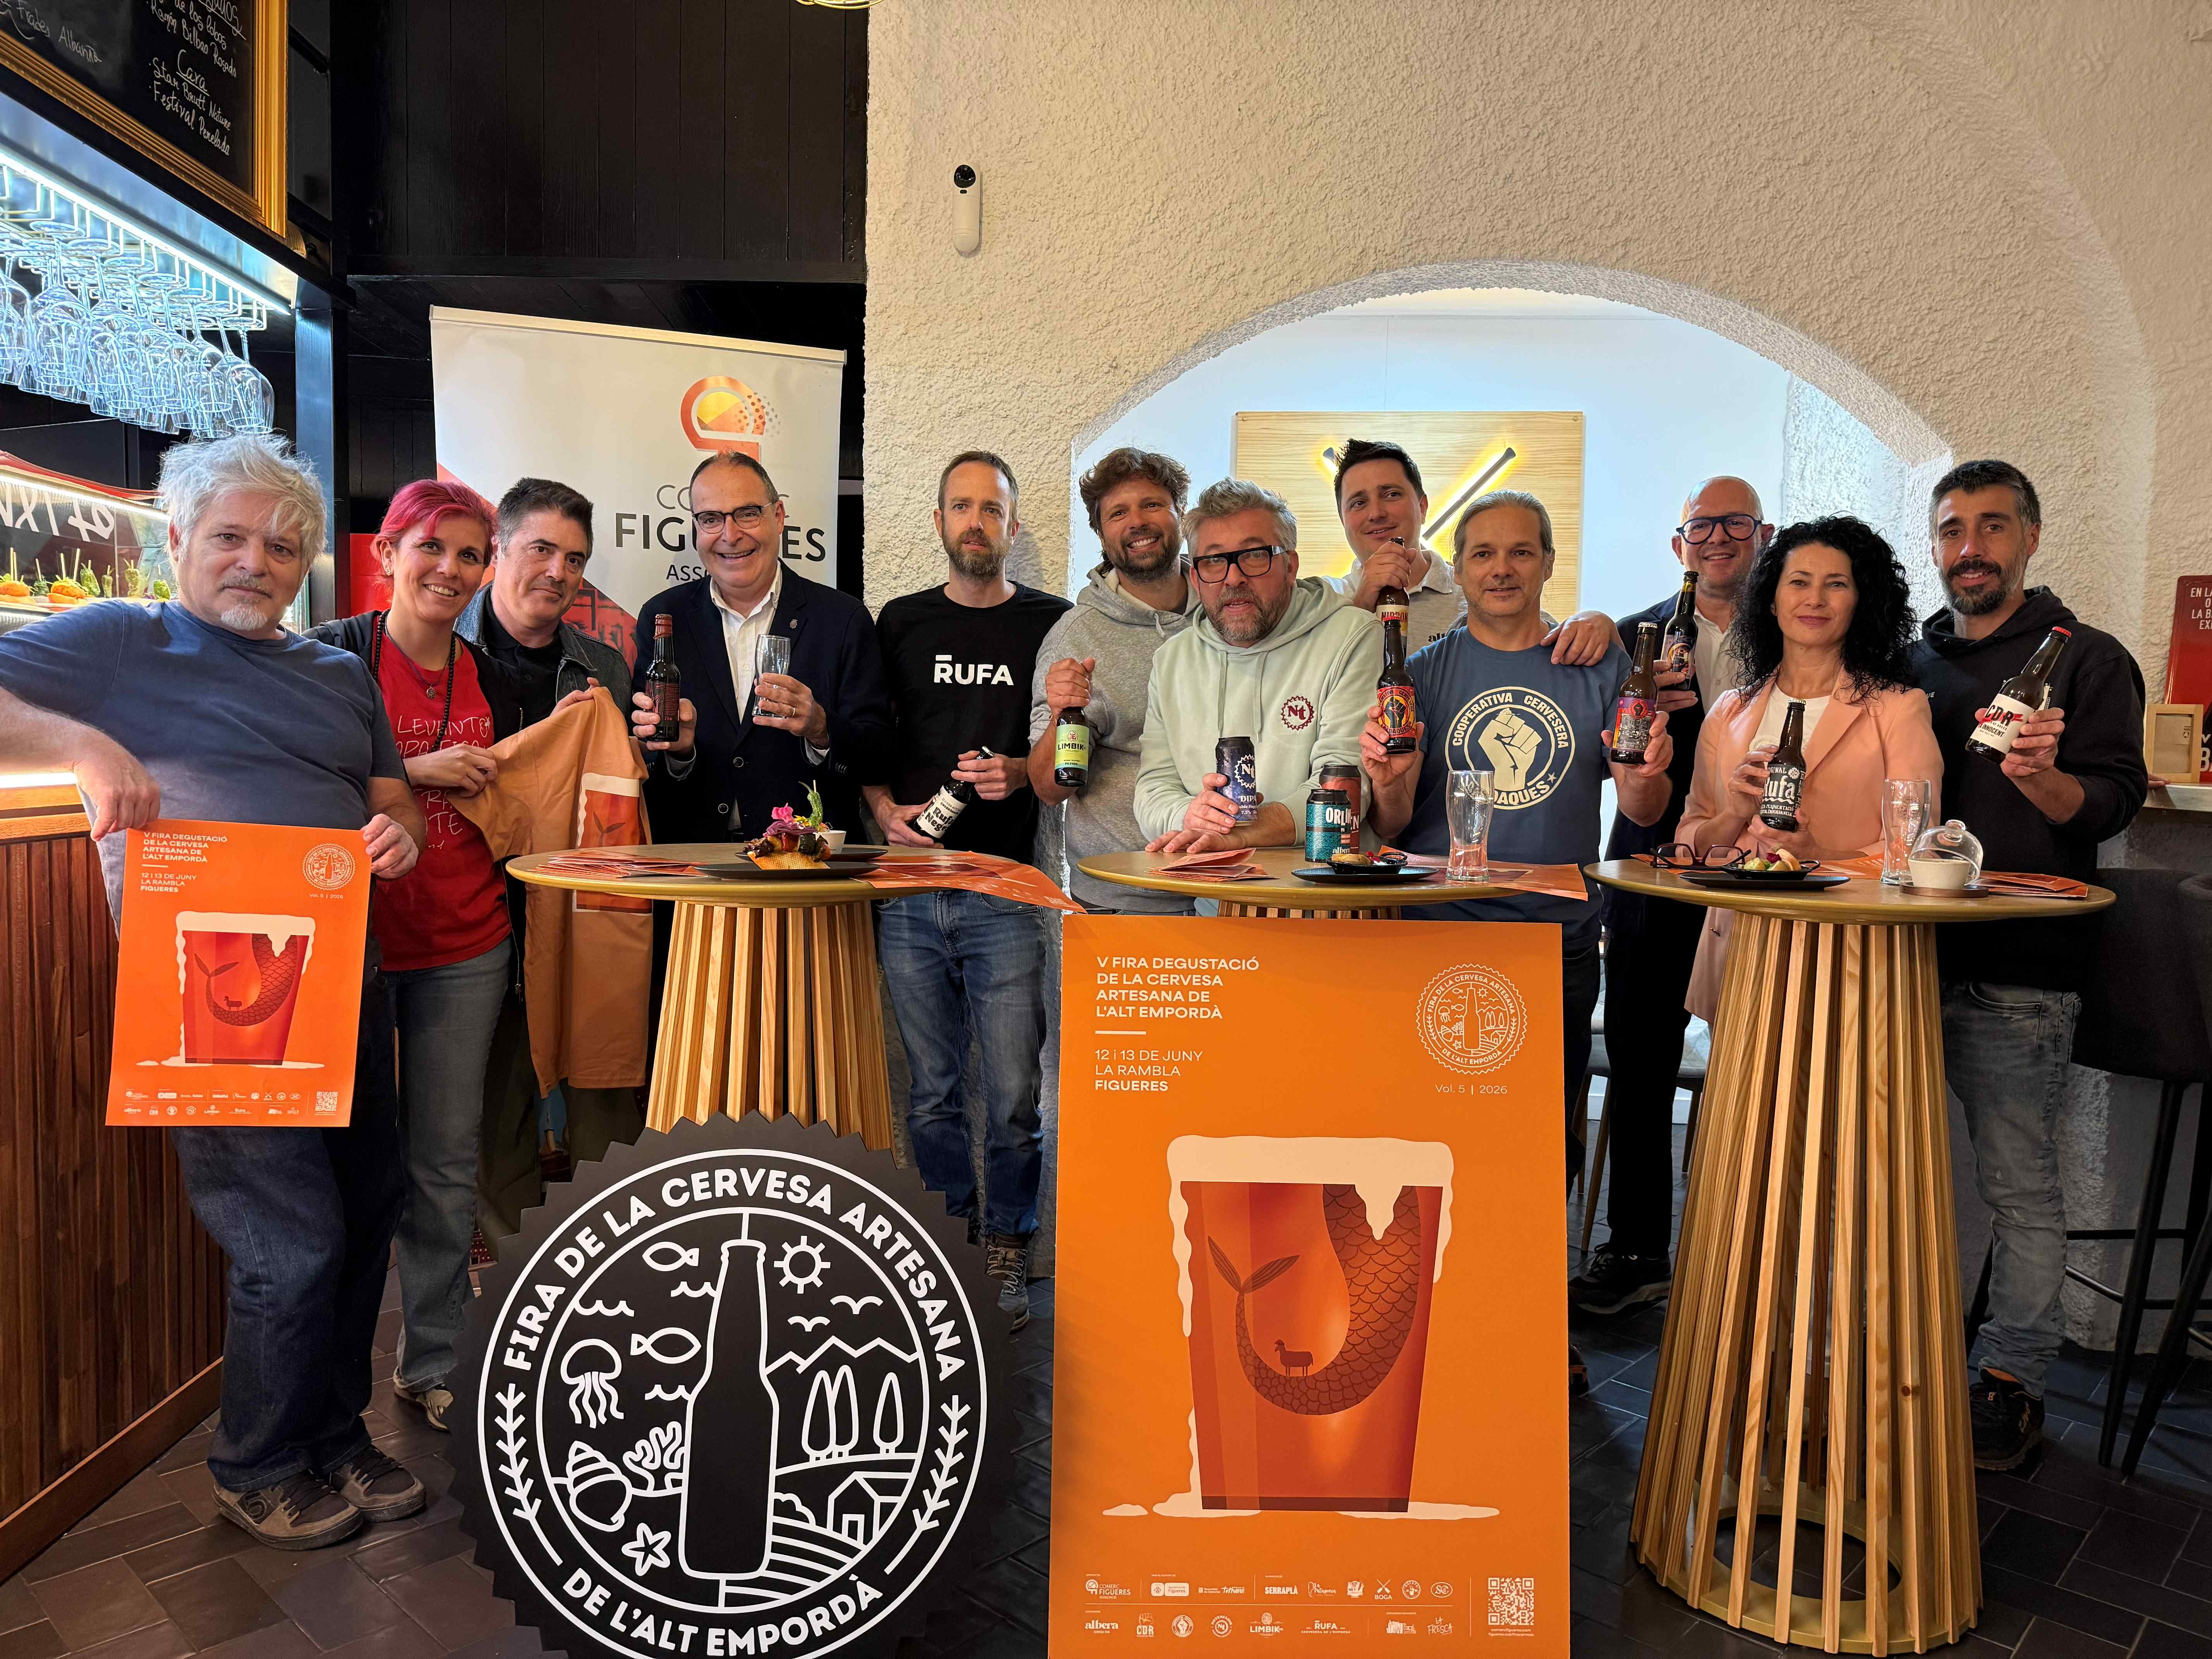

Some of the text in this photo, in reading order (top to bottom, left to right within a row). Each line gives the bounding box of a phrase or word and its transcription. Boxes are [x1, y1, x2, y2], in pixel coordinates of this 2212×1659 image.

[182, 19, 208, 55] Bilbao
[177, 49, 208, 92] Cava
[154, 80, 195, 130] Festival
[615, 512, 826, 562] FIGES
[2191, 588, 2202, 597] EN
[2191, 609, 2212, 619] LA B
[934, 654, 1014, 686] RUFA
[1452, 692, 1569, 749] COOPERATIVA CERVESERA
[1985, 705, 2014, 726] CDR
[173, 834, 227, 842] DEGUSTACIÓ
[1097, 956, 1259, 970] V FIRA DEGUSTACIÓ
[1097, 973, 1223, 986] DE LA CERVESA
[1096, 989, 1210, 1002] ARTESANA DE
[1428, 974, 1515, 1014] FIRA DE LA CERVESA ARTESANA
[1096, 1005, 1223, 1019] L'ALT EMPORDÀ
[1095, 1049, 1109, 1060] 12
[1120, 1049, 1135, 1060] 13
[1140, 1050, 1159, 1061] DE
[1162, 1051, 1203, 1061] JUNY
[1442, 1048, 1502, 1065] DE L'ALT EMPORDÀ
[1096, 1065, 1181, 1076] LA RAMBLA
[1095, 1080, 1168, 1091] FIGUERES
[1435, 1084, 1507, 1094] Vol. 5 2026
[503, 1168, 965, 1381] FIRA DE LA CERVESA ARTESANA
[1265, 1585, 1298, 1594] SERRAPLÀ
[563, 1568, 611, 1615] DE
[707, 1574, 883, 1656] EMPORDÀ
[1085, 1620, 1119, 1629] albera
[1137, 1625, 1154, 1635] CDR
[1314, 1620, 1337, 1630] RUFA
[1427, 1623, 1453, 1634] FRESCA
